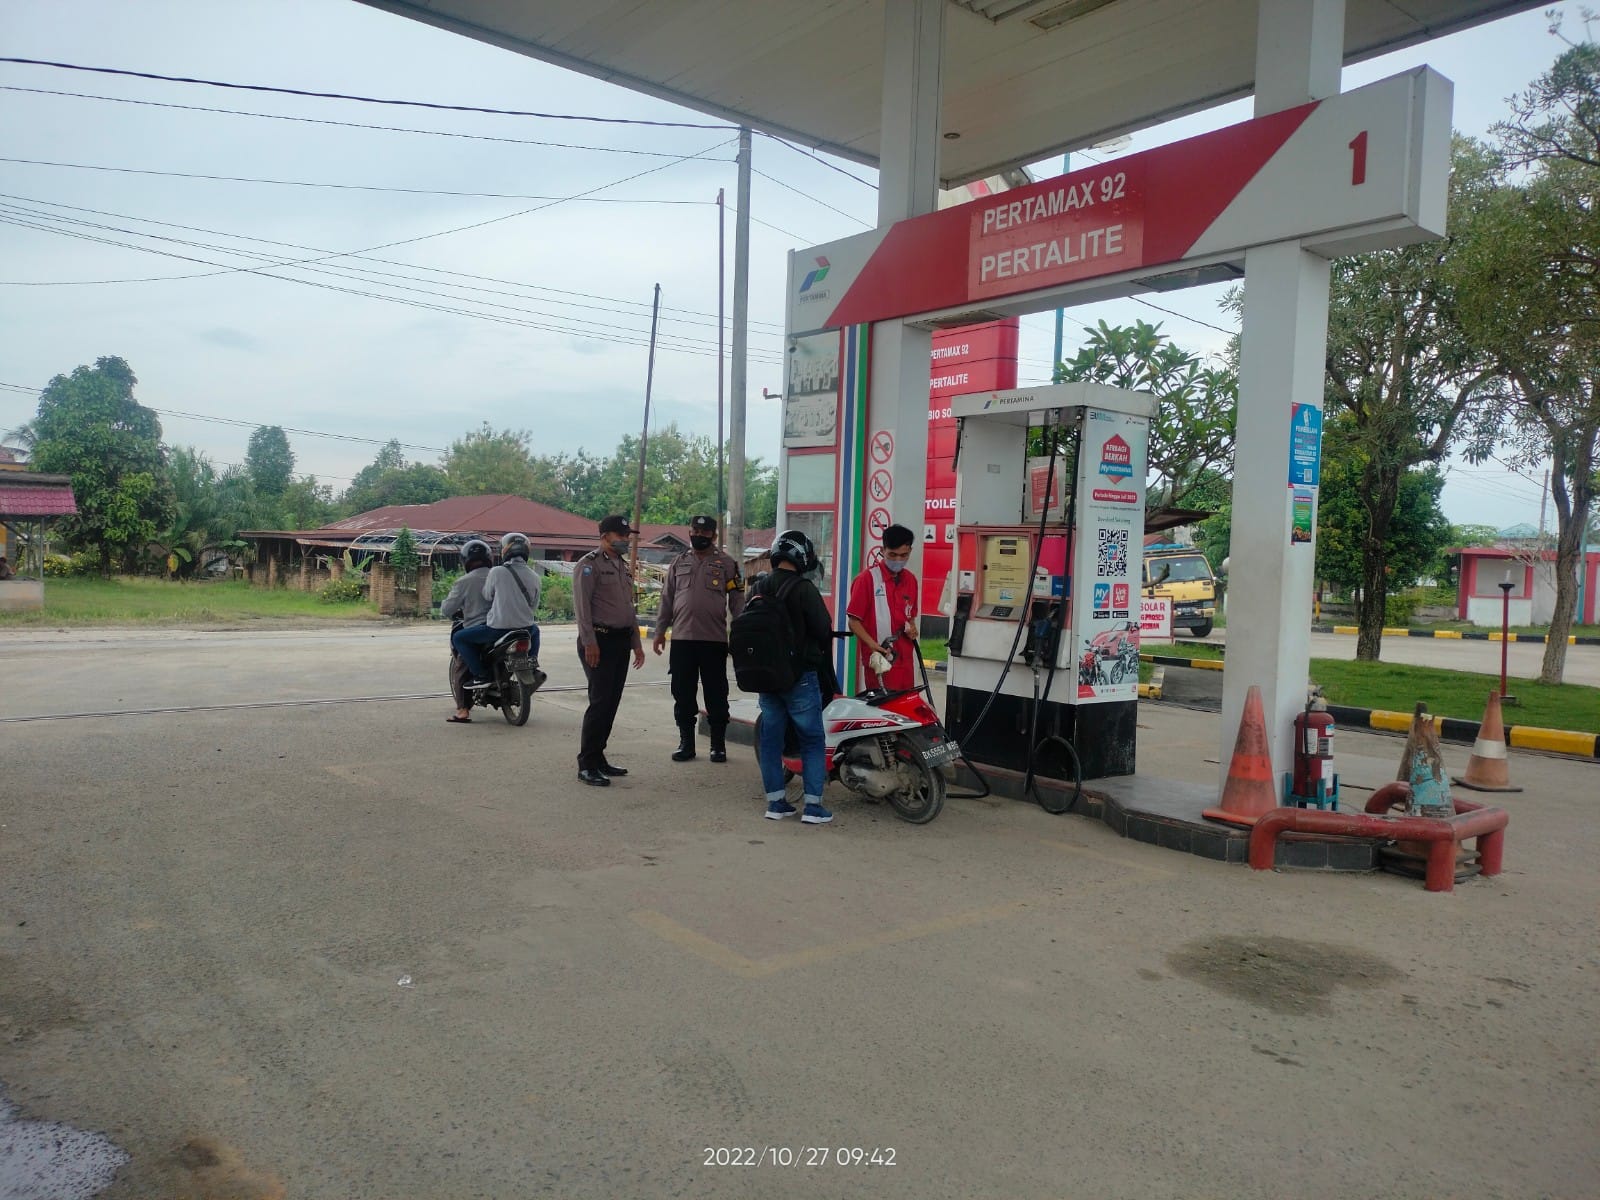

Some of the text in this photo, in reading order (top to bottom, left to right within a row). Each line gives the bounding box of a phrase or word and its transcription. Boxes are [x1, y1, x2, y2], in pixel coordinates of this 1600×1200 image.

[1348, 130, 1368, 186] 1
[983, 172, 1126, 234] PERTAMAX 92
[981, 225, 1123, 282] PERTALITE
[930, 344, 969, 360] PERTAMAX 92
[929, 373, 969, 388] PERTALITE
[999, 395, 1034, 405] PERTAMINA
[928, 409, 940, 420] BIO
[1104, 452, 1128, 462] BERKAH
